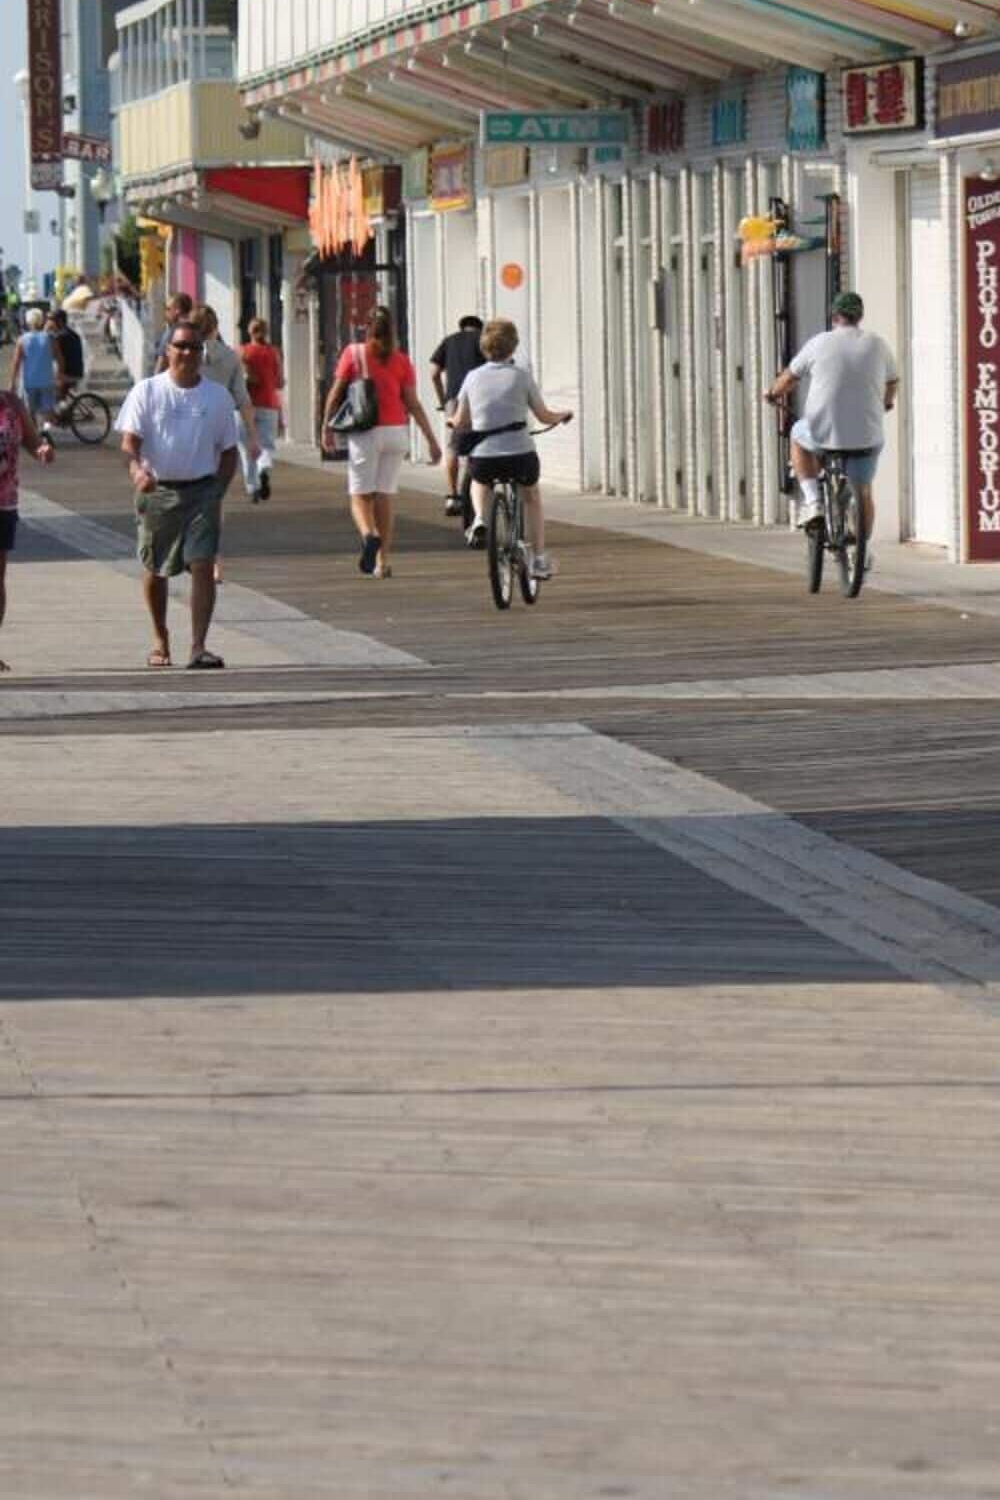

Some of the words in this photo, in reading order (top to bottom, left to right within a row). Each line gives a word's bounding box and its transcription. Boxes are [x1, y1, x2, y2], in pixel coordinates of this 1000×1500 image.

[516, 115, 599, 139] ATM
[66, 140, 110, 162] BAR
[975, 240, 998, 348] PHOTO
